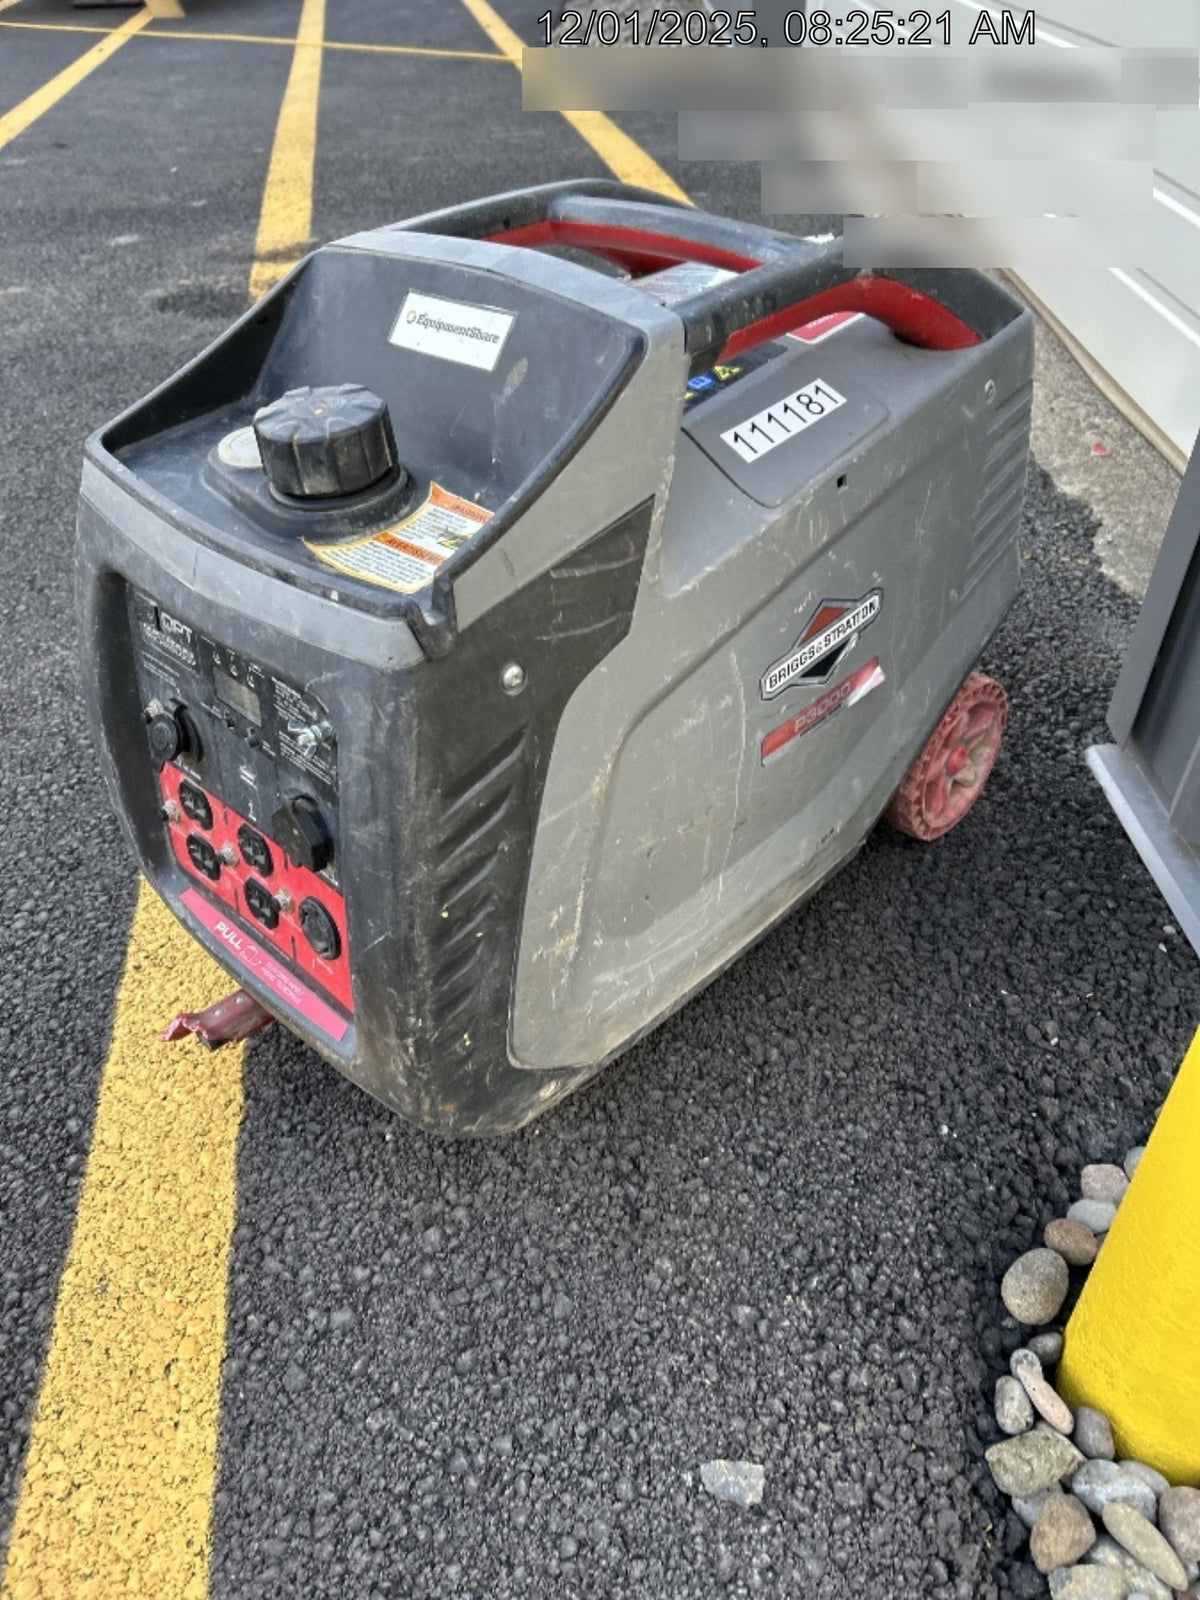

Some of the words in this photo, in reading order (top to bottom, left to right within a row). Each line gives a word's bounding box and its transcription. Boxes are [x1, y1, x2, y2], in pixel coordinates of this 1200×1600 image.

[415, 313, 500, 344] EquipmentShare
[733, 384, 840, 455] 111181
[214, 920, 243, 951] PULL
